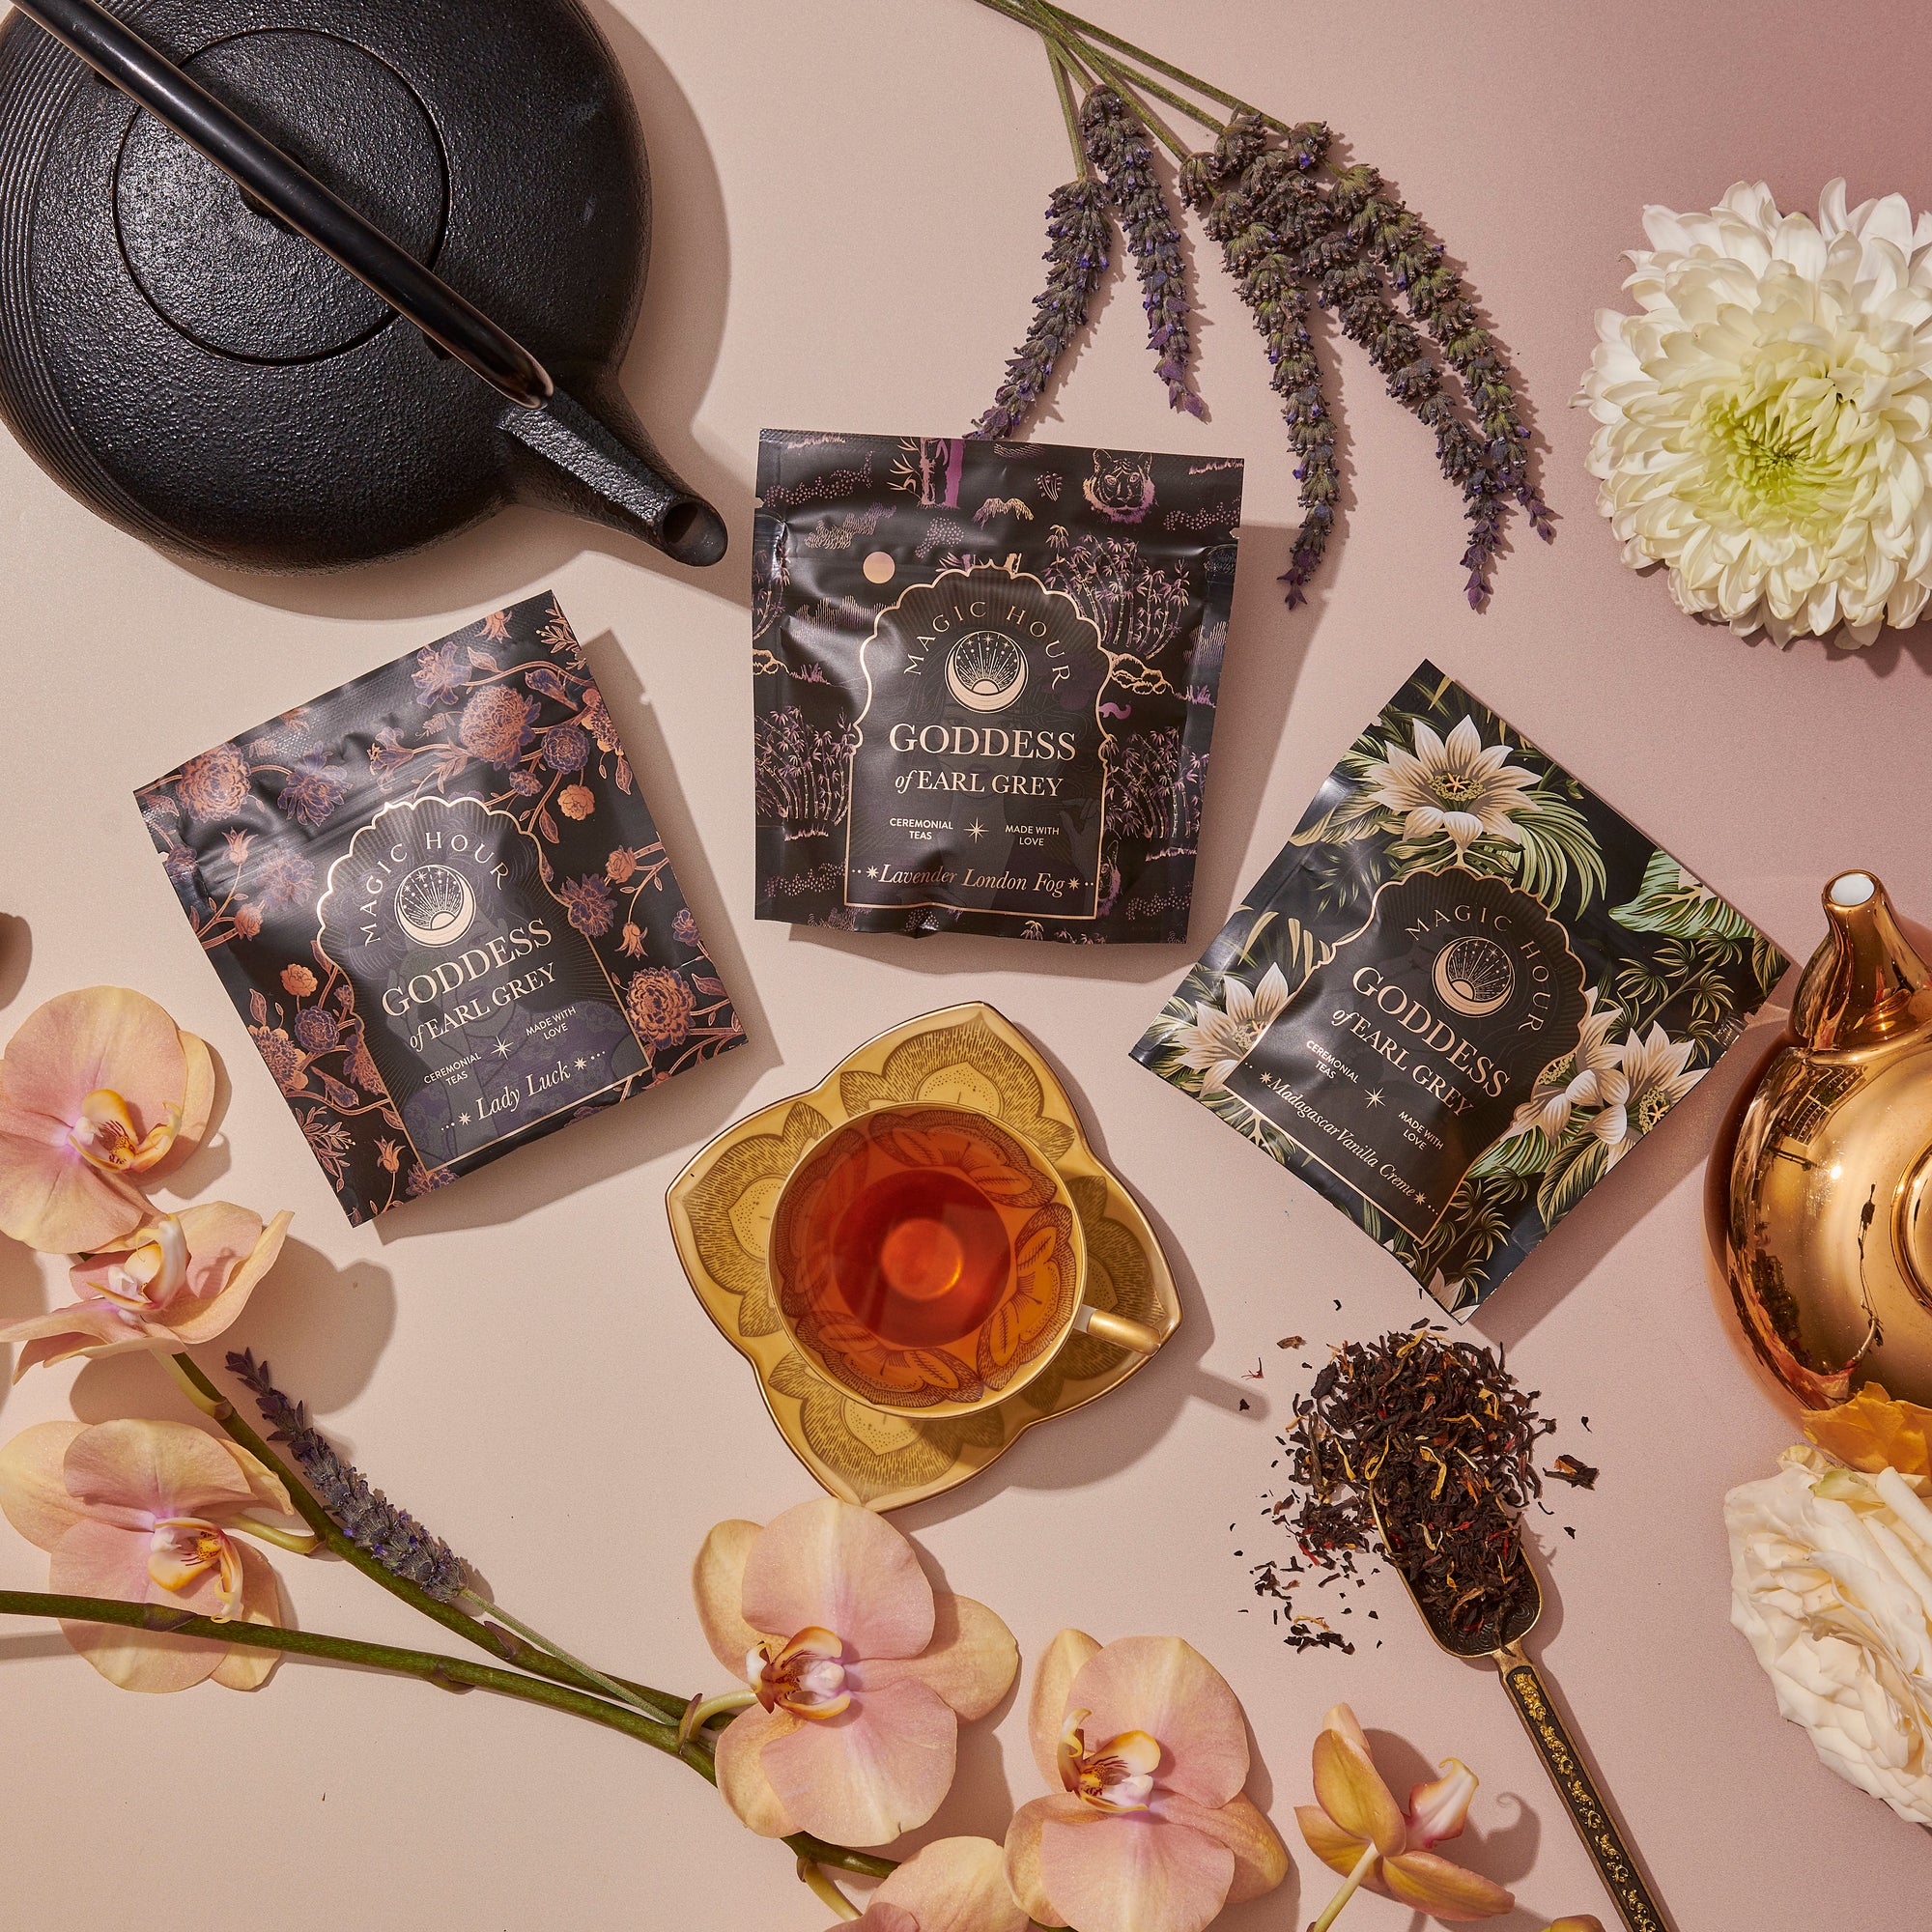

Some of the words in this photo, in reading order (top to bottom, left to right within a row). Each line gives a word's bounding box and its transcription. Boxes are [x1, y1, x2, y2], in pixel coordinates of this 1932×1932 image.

[904, 602, 986, 674] MAGIC
[1007, 606, 1069, 691] HOUR
[890, 724, 1075, 761] GODDESS
[895, 770, 917, 792] of
[918, 771, 984, 793] EARL
[992, 774, 1063, 797] GREY
[890, 818, 952, 830] CEREMONIAL
[910, 831, 932, 839] TEAS
[1006, 825, 1034, 835] MADE
[1036, 826, 1060, 836] WITH
[1020, 837, 1043, 845] LOVE
[359, 843, 408, 946] MAGIC
[426, 832, 510, 890] HOUR
[878, 865, 957, 884] Lavender
[962, 868, 1027, 890] London
[1033, 873, 1065, 897] Fog
[382, 918, 553, 1016] GODDESS
[1406, 904, 1512, 941] MAGIC
[1517, 941, 1550, 1032] HOUR
[410, 1025, 431, 1051] of
[423, 998, 490, 1040] EARL
[492, 962, 556, 1009] GREY
[526, 1018, 552, 1037] MADE
[552, 1007, 576, 1025] WITH
[543, 1023, 568, 1040] LOVE
[1352, 966, 1511, 1097] GODDESS
[424, 1053, 481, 1084] CEREMONIAL
[445, 1071, 468, 1086] TEAS
[1307, 1040, 1358, 1084] CEREMONIAL
[1315, 1062, 1337, 1080] TEAS
[1332, 1006, 1355, 1026] of
[1350, 1019, 1407, 1072] EARL
[1412, 1065, 1474, 1117] GREY
[475, 1086, 520, 1121] Lady
[526, 1061, 571, 1096] Luck
[1267, 1079, 1340, 1137] Madagascar
[1338, 1127, 1378, 1168] Vanilla
[1379, 1163, 1415, 1198] Creme
[1399, 1111, 1423, 1135] MADE
[1423, 1129, 1443, 1151] WITH
[1403, 1130, 1427, 1151] LOVE
